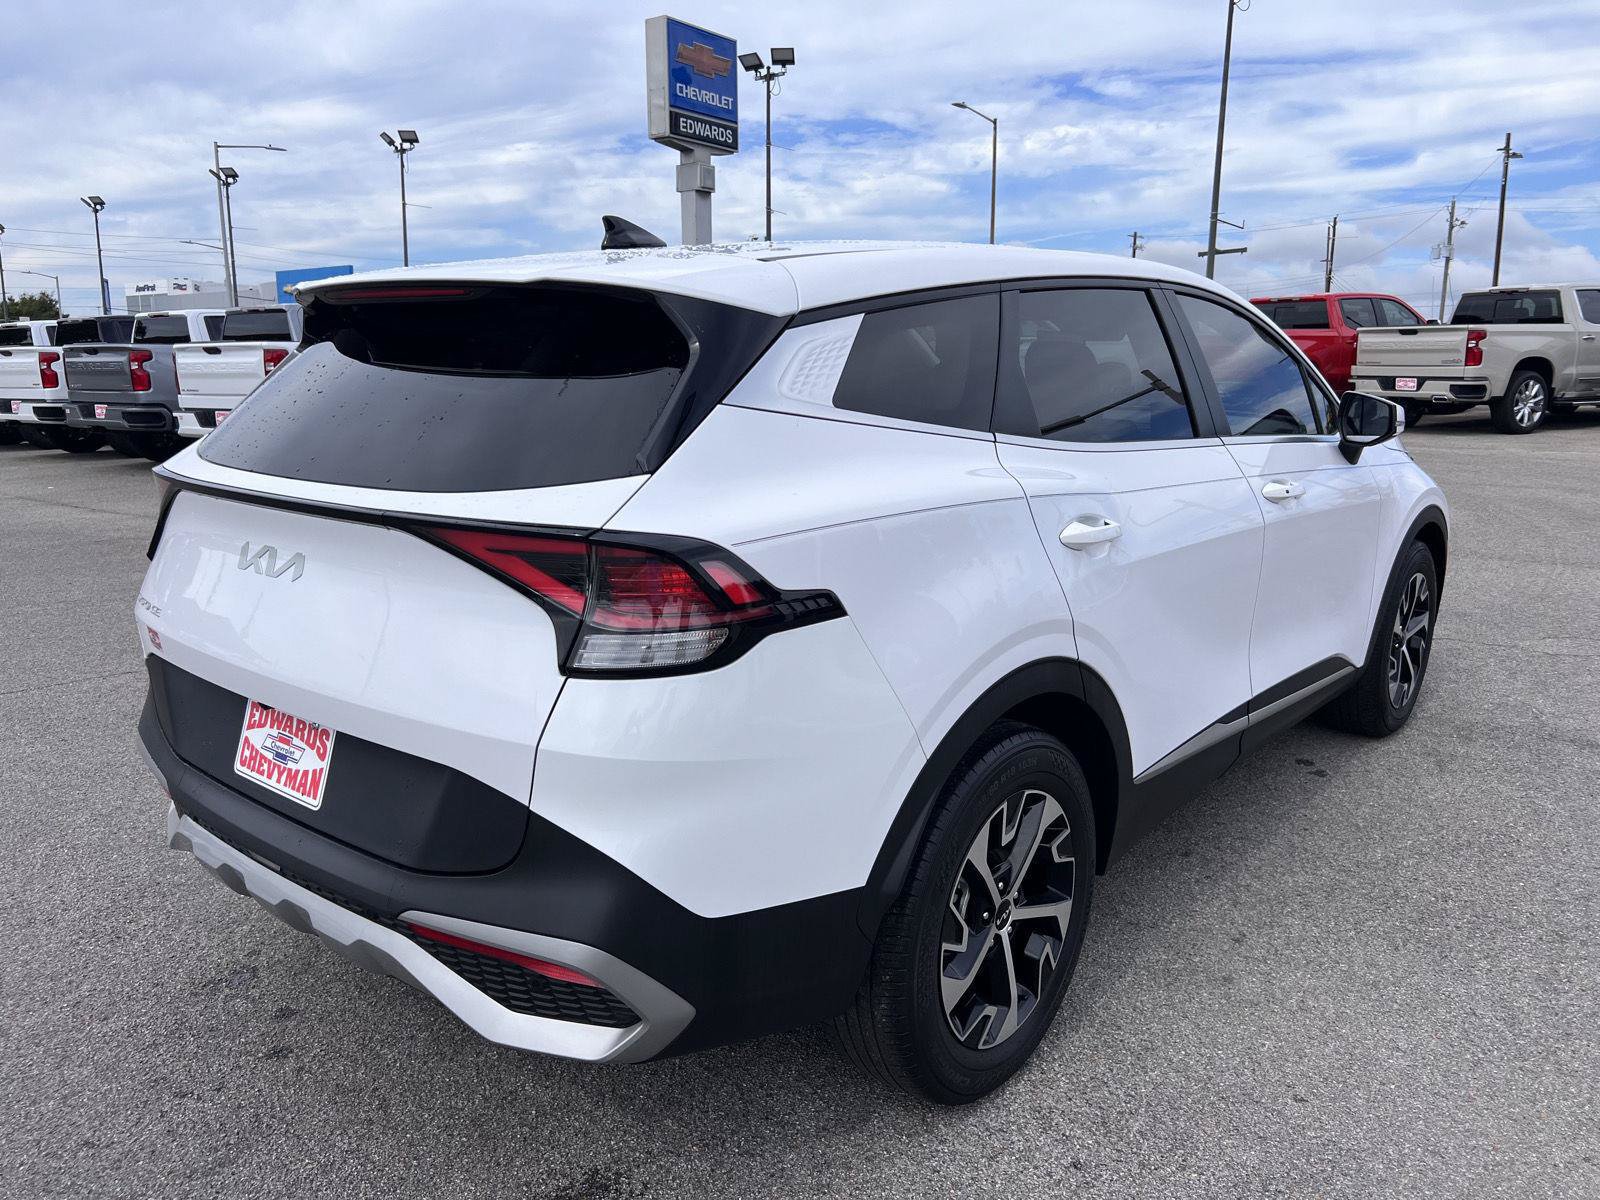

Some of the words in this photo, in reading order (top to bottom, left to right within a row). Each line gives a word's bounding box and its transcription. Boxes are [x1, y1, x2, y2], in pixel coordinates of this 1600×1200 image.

[676, 83, 733, 109] CHEVROLET
[680, 117, 733, 143] EDWARDS
[246, 700, 330, 762] EDWARDS
[270, 741, 296, 756] Chevrolet
[239, 735, 324, 801] CHEVYMAN
